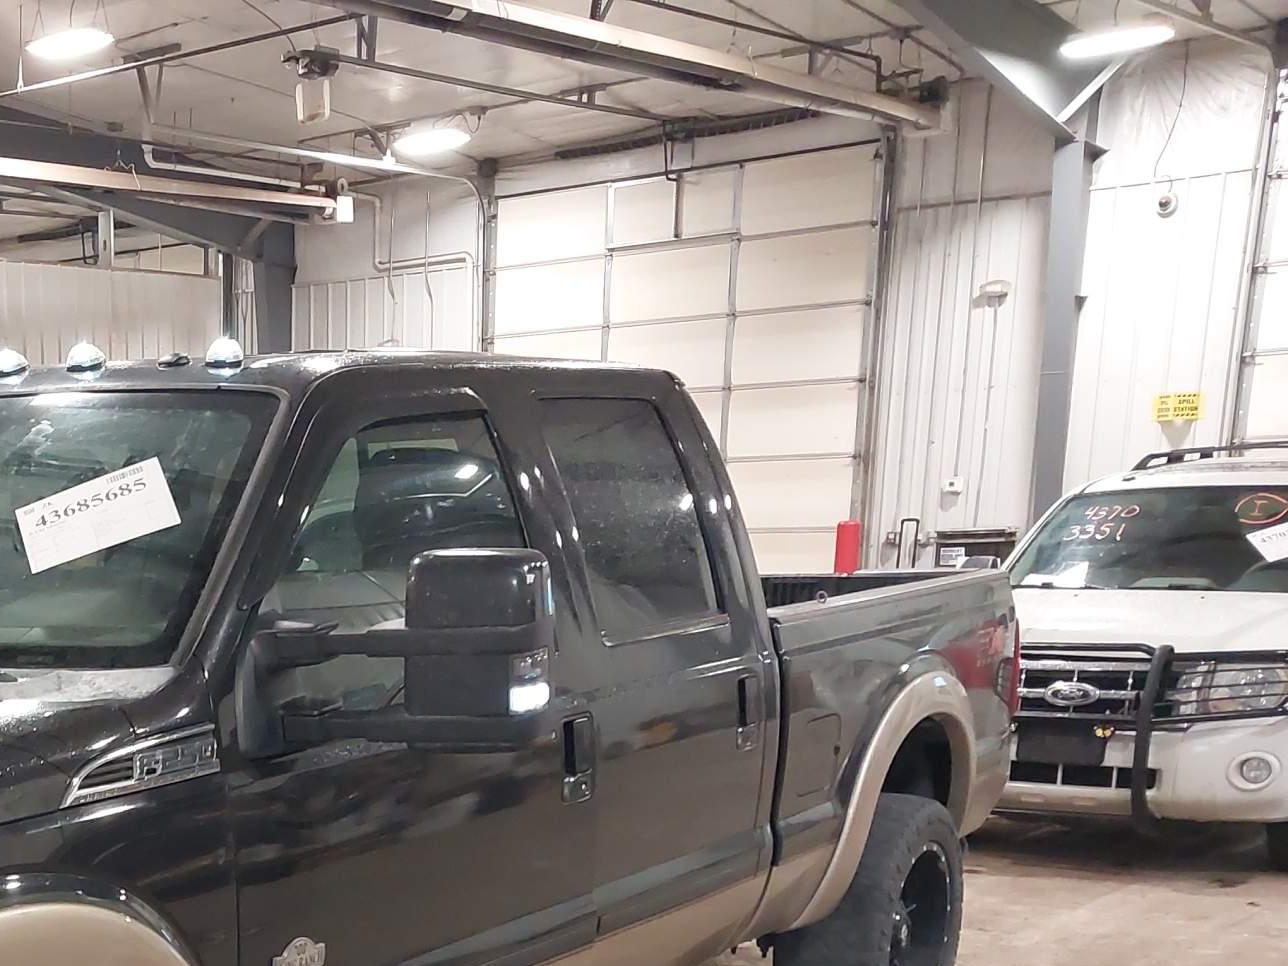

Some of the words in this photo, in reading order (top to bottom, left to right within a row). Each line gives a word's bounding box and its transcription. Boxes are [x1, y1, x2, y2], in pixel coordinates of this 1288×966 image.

[35, 477, 147, 528] 43685685
[1084, 504, 1141, 520] 4370
[1063, 522, 1126, 541] 3351
